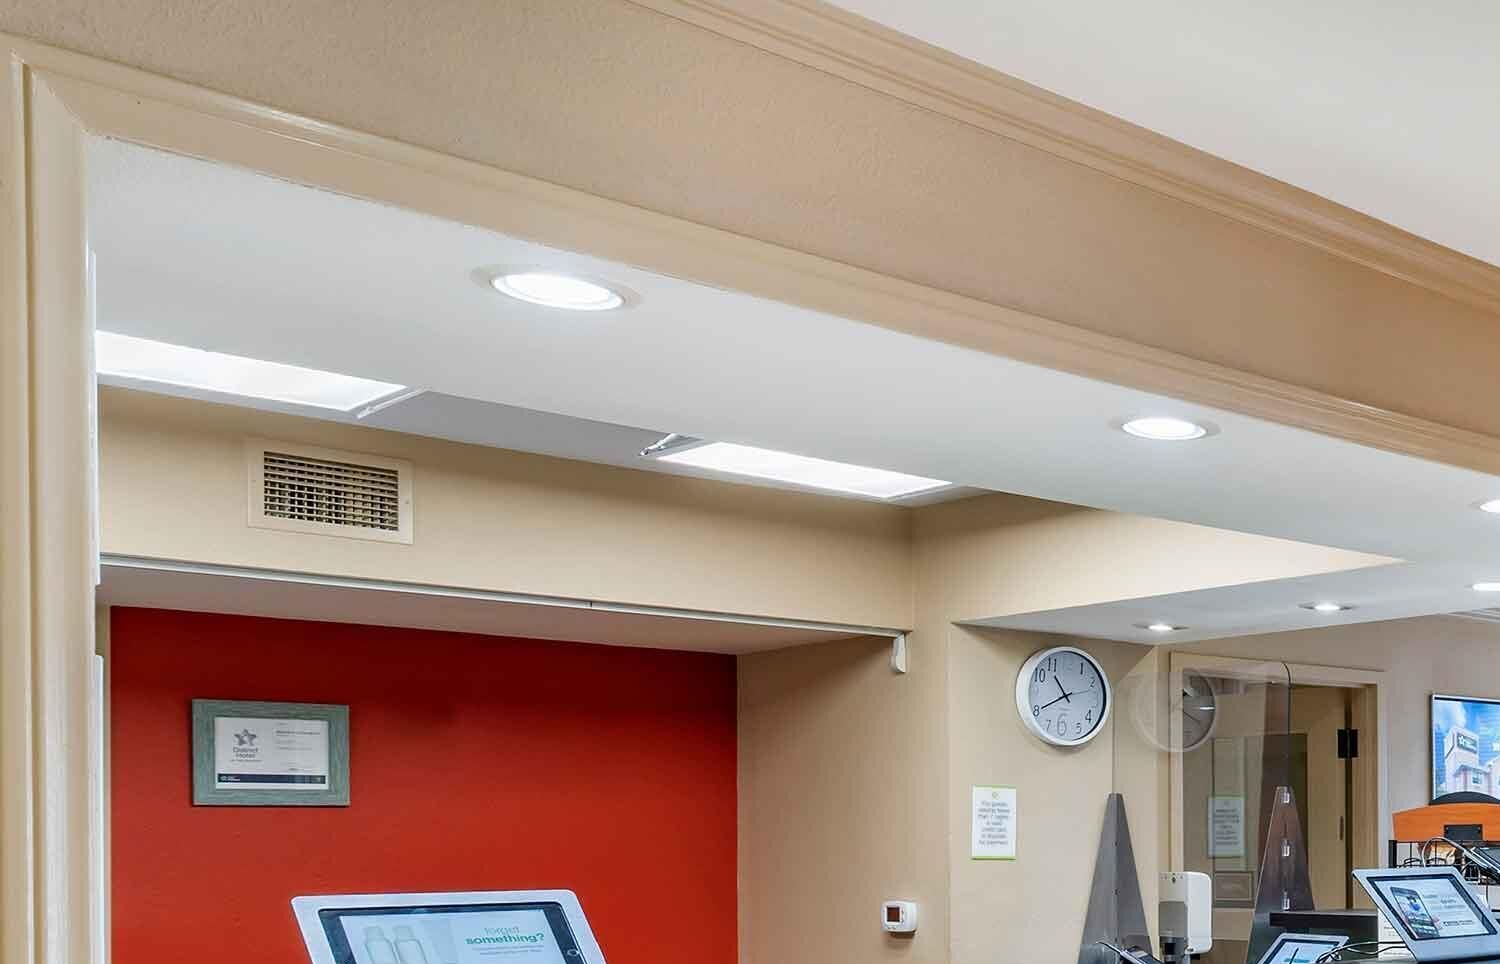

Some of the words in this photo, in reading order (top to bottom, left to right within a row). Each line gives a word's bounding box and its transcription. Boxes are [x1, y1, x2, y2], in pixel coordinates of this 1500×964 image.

[1047, 657, 1057, 672] 11
[1034, 667, 1046, 683] 10
[1033, 704, 1040, 717] 8
[464, 932, 545, 945] something?
